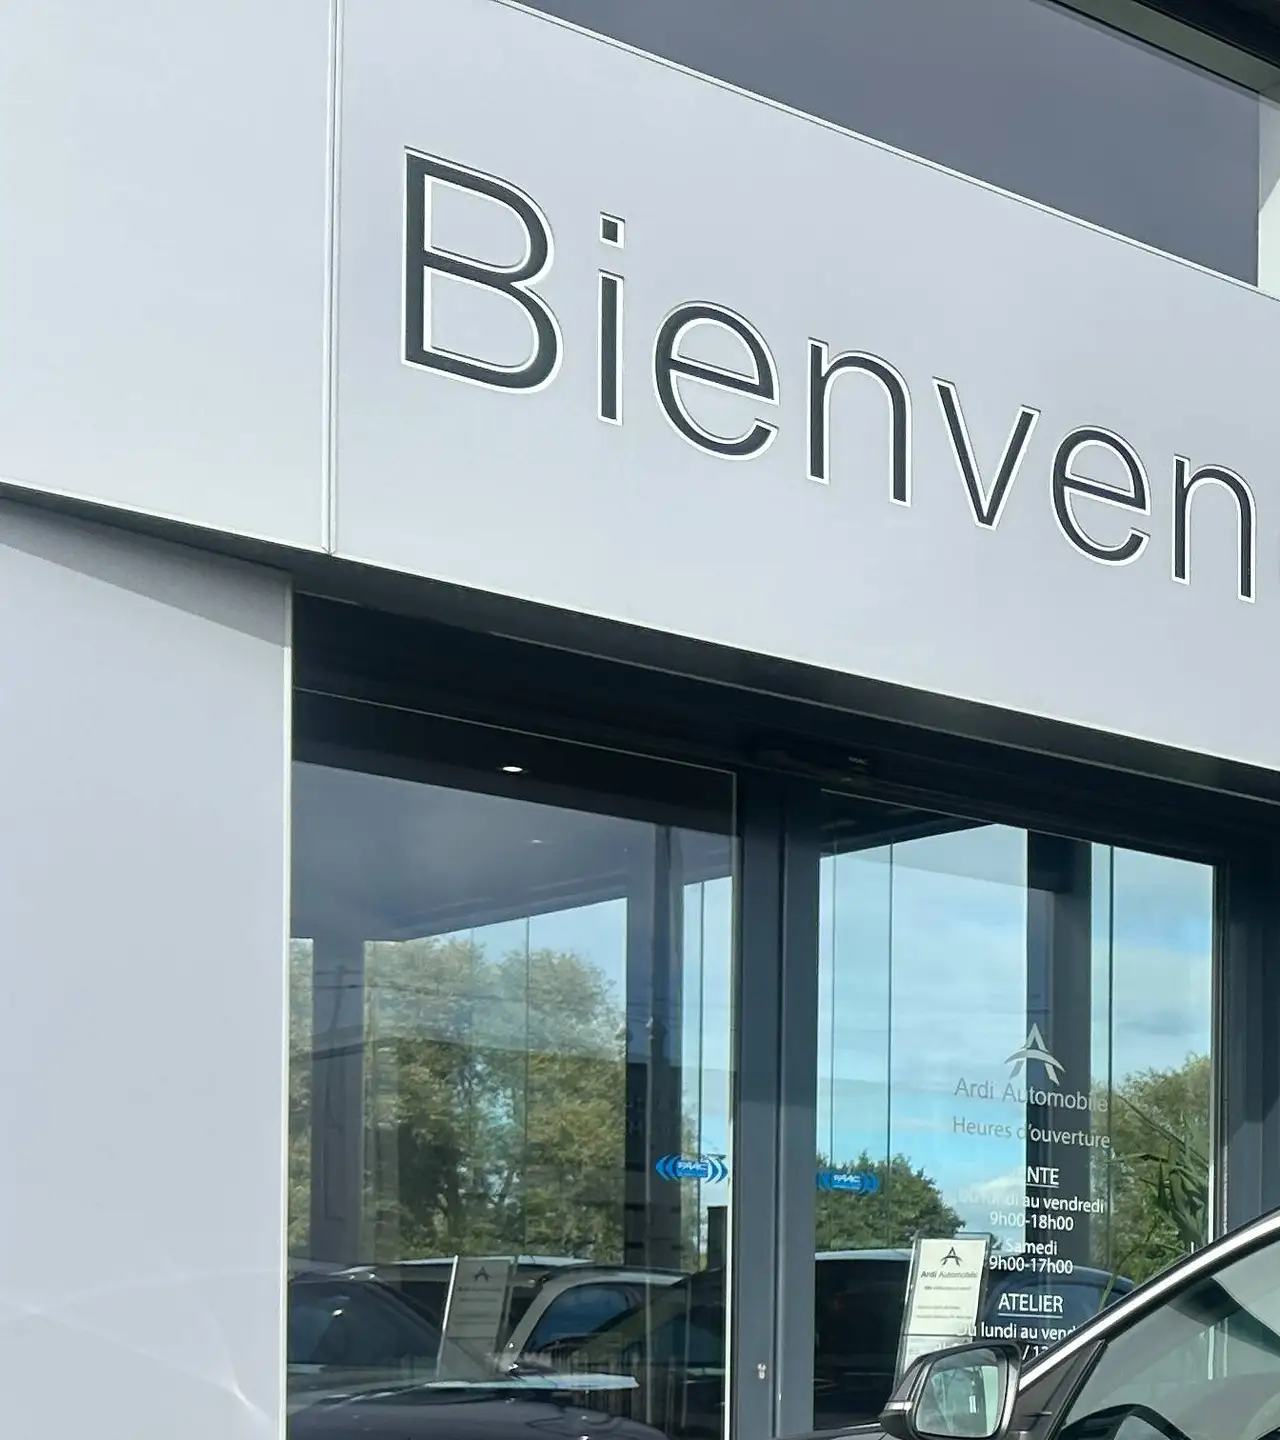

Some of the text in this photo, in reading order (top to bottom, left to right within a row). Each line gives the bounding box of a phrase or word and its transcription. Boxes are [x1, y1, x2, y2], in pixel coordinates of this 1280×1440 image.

[954, 1077, 1109, 1113] Ardi Automobile
[952, 1116, 1111, 1149] Heures d'ouverture
[1022, 1196, 1040, 1208] au
[1043, 1195, 1104, 1214] vendredi
[989, 1210, 1074, 1232] 9h00-18h00
[1005, 1237, 1058, 1256] Samedi
[988, 1255, 1074, 1275] 9h00-17h00
[998, 1292, 1064, 1313] ATELIER
[980, 1321, 1017, 1339] lundi
[1020, 1328, 1039, 1340] au
